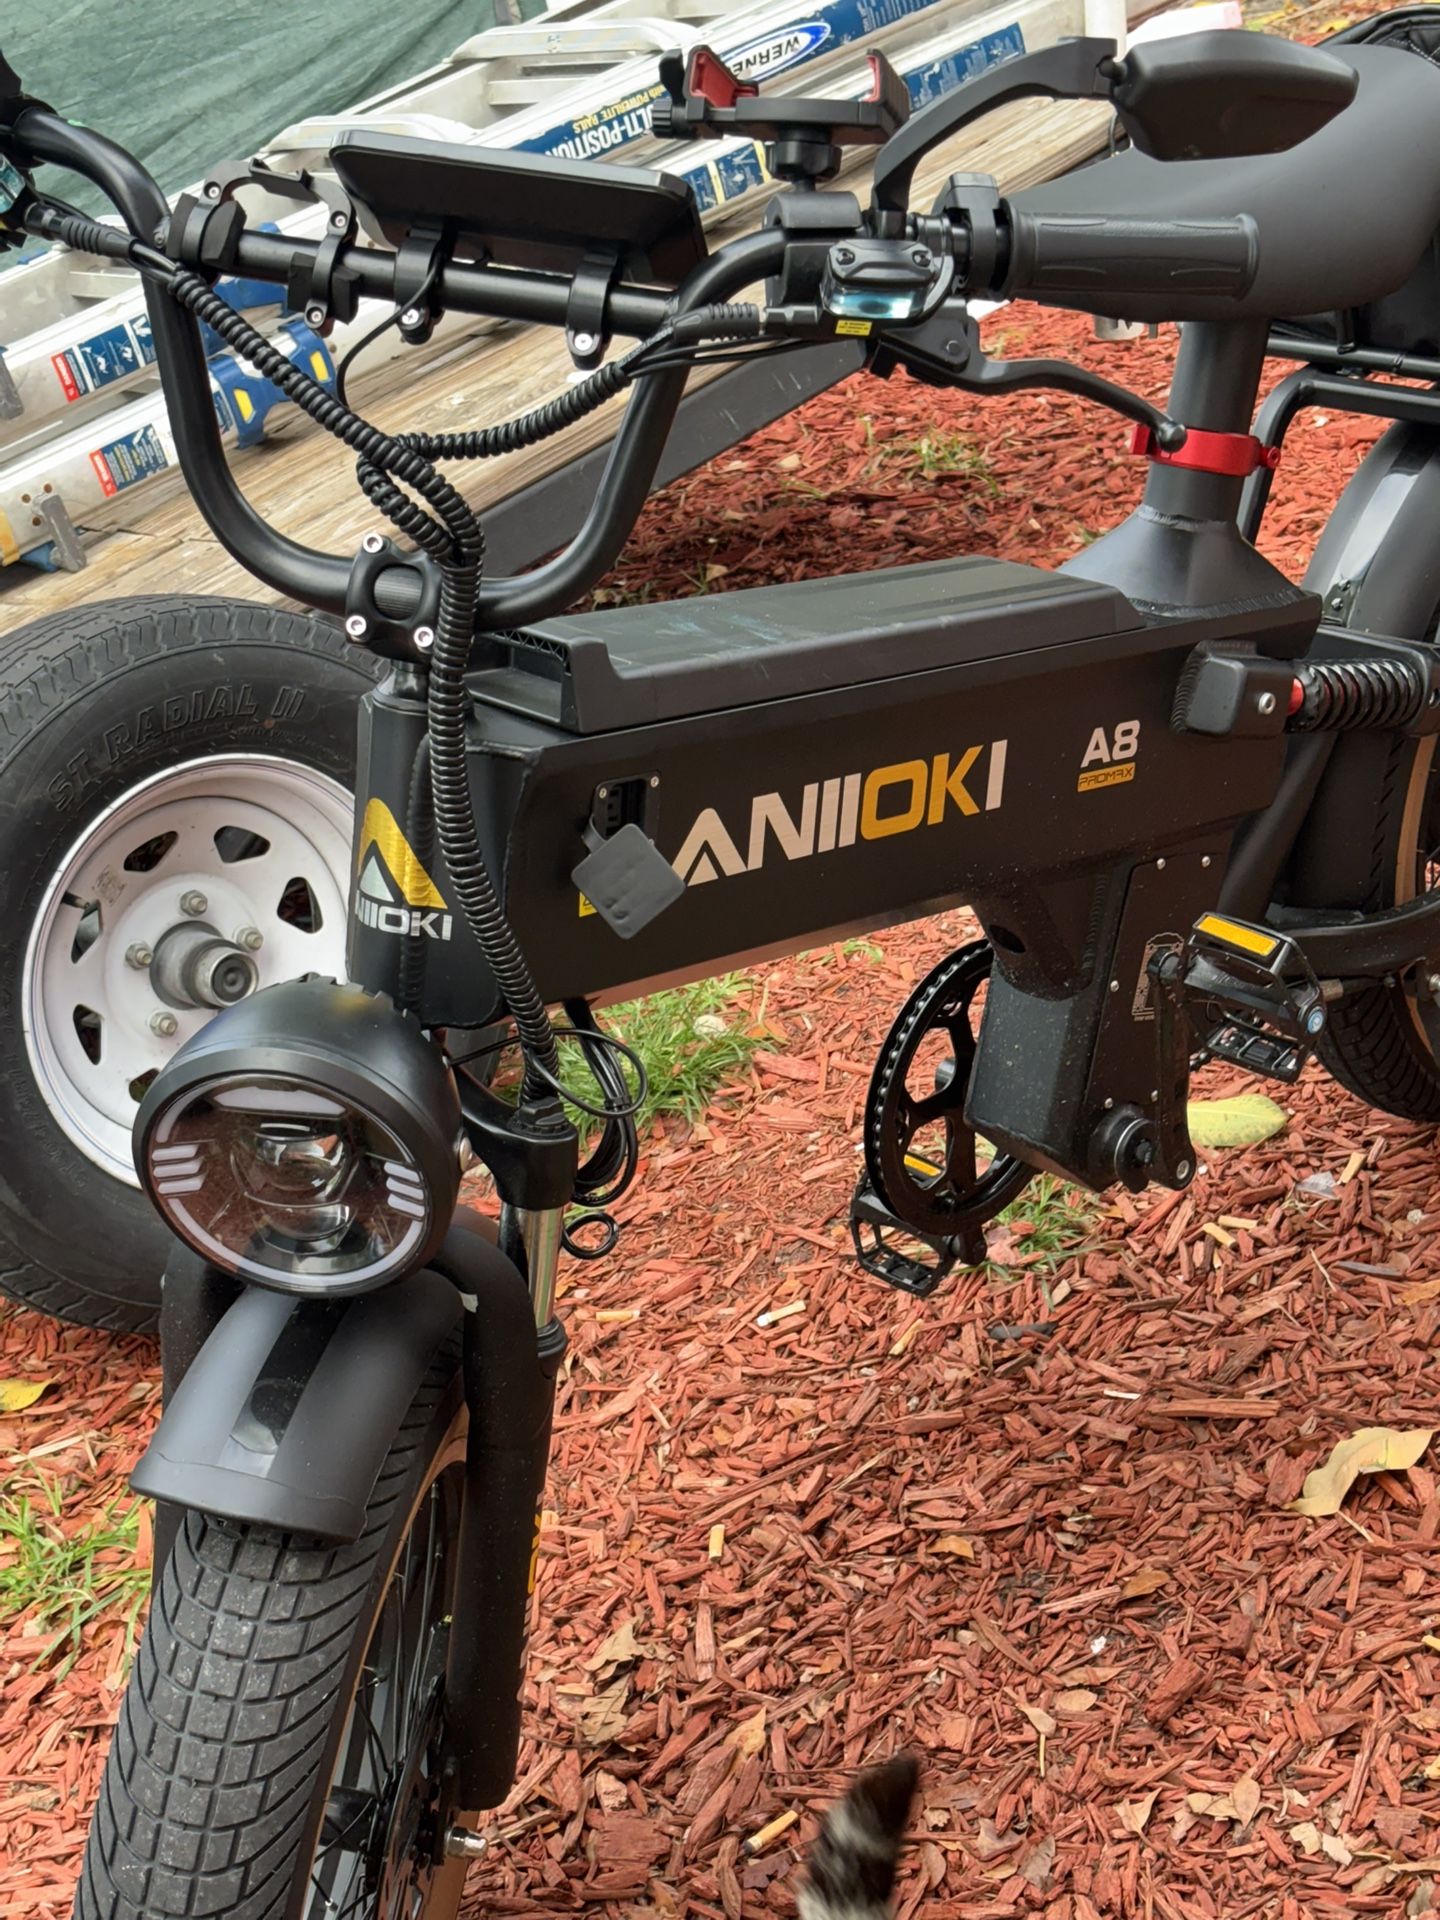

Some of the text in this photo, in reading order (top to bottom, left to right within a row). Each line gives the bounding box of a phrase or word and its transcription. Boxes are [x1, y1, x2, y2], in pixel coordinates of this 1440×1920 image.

[731, 35, 801, 77] WERNE
[572, 114, 599, 134] RAILS
[600, 90, 650, 123] POWERLITE
[102, 683, 258, 764] RADIAL
[270, 685, 306, 720] II
[1080, 719, 1140, 768] A8
[1079, 765, 1135, 786] PROMAX
[671, 739, 1008, 887] ANIIOKI
